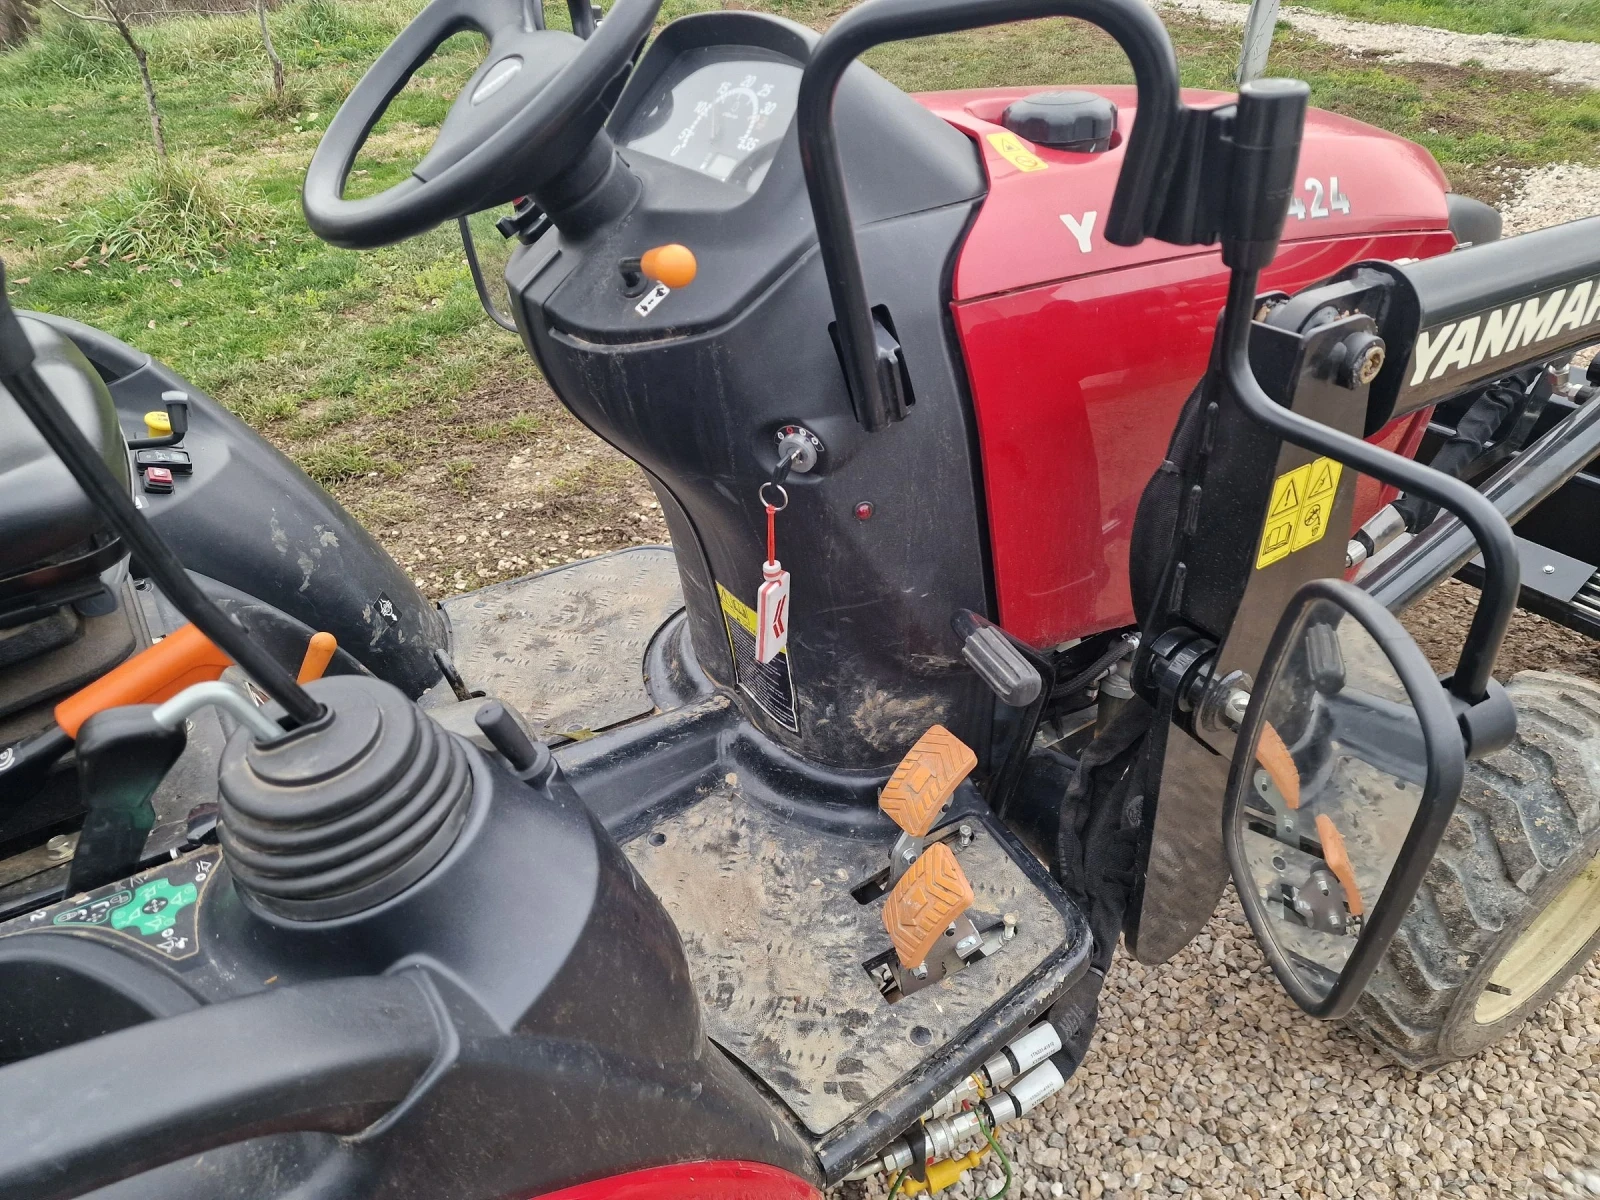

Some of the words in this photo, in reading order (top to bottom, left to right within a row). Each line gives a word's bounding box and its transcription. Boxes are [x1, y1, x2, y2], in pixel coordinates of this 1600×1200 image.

[740, 74, 757, 88] 20
[757, 83, 775, 97] 25
[694, 101, 708, 114] 10
[760, 101, 777, 115] 30
